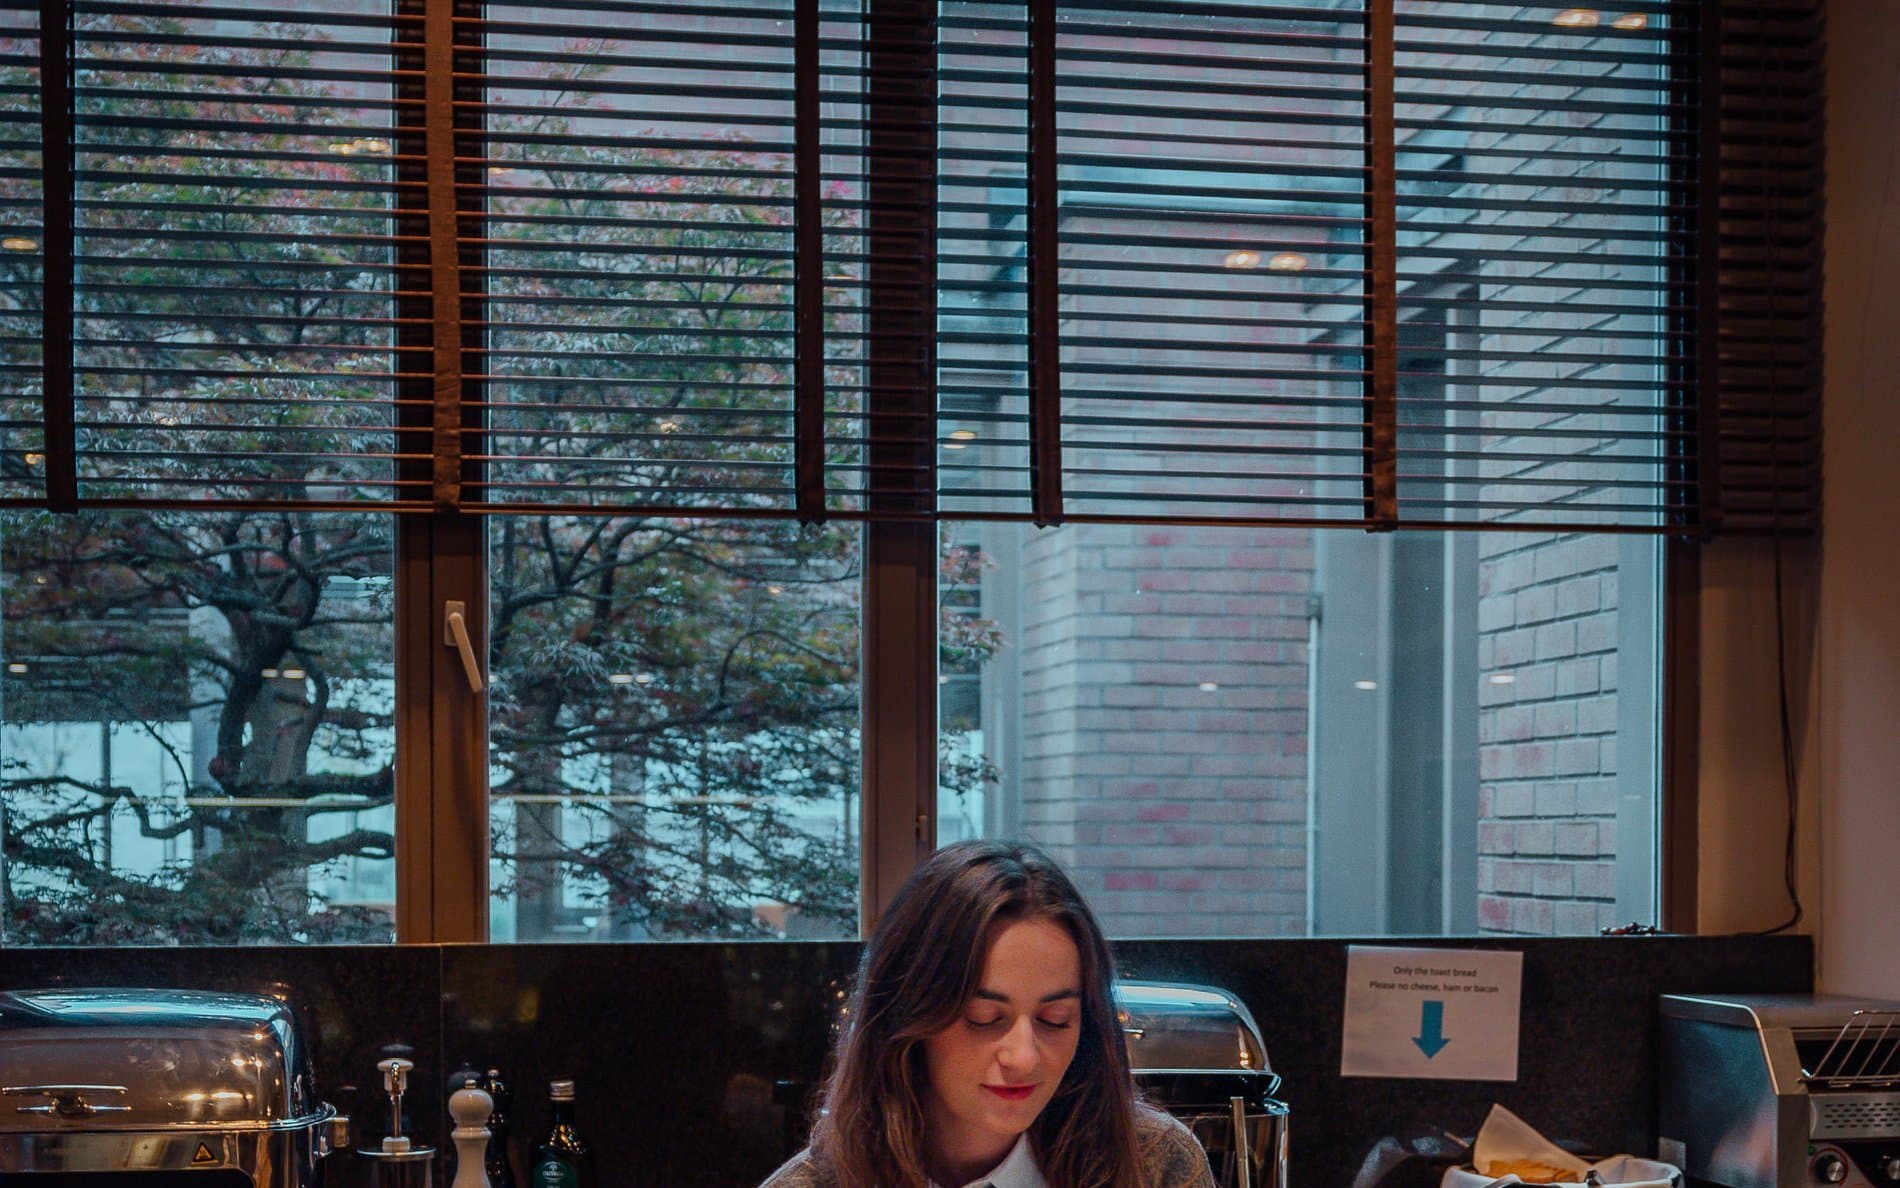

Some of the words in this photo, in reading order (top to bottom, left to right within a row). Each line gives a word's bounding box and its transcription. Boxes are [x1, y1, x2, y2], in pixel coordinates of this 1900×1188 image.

[1393, 966, 1413, 976] Only
[1415, 967, 1428, 975] the
[1430, 968, 1451, 976] toast
[1453, 968, 1477, 977] bread
[1369, 980, 1395, 989] Please
[1443, 984, 1462, 992] ham
[1474, 984, 1499, 993] bacon
